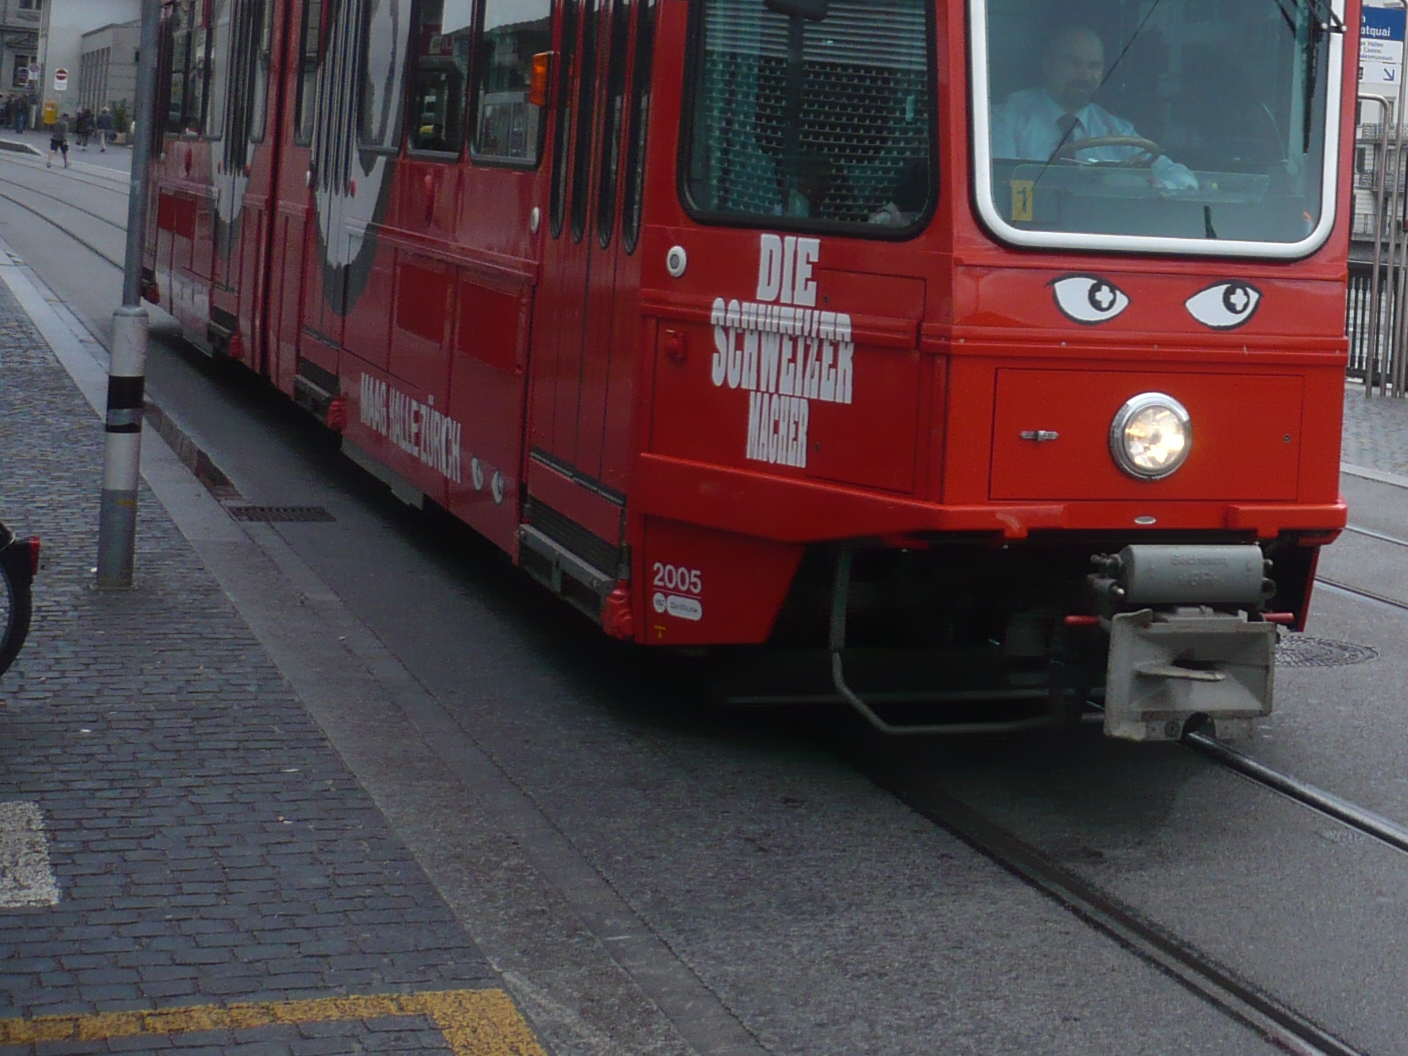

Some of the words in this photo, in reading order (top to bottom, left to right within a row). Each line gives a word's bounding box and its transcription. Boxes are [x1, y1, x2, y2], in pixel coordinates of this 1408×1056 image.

[1360, 25, 1391, 37] atquai
[1015, 186, 1028, 214] 1
[756, 233, 821, 307] DIE
[710, 297, 855, 405] SCHWEIZER
[388, 386, 420, 459] HALLE
[419, 394, 462, 484] ZÜRICH
[745, 392, 810, 469] MACHER
[653, 561, 702, 594] 2005
